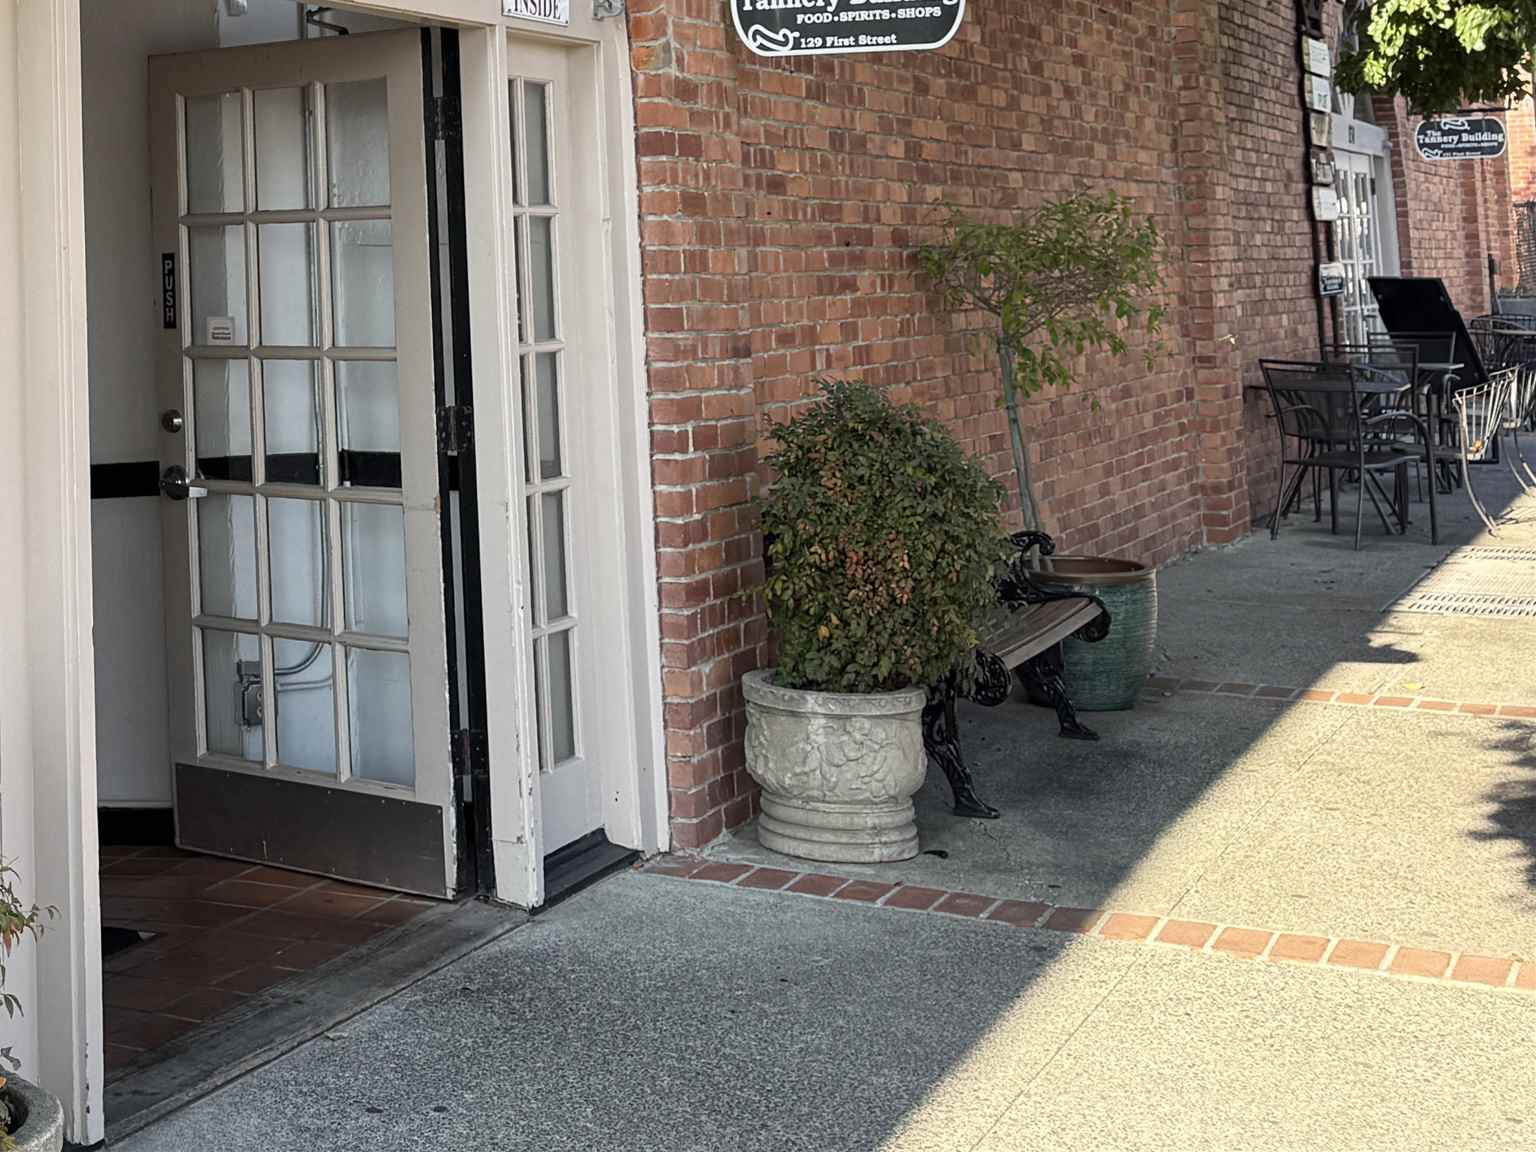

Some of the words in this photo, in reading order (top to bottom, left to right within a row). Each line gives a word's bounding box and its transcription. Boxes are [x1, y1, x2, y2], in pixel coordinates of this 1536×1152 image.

[800, 38, 823, 48] 129
[826, 35, 856, 47] First
[859, 34, 897, 45] Street
[1462, 132, 1504, 142] Building
[164, 260, 174, 322] PUSH
